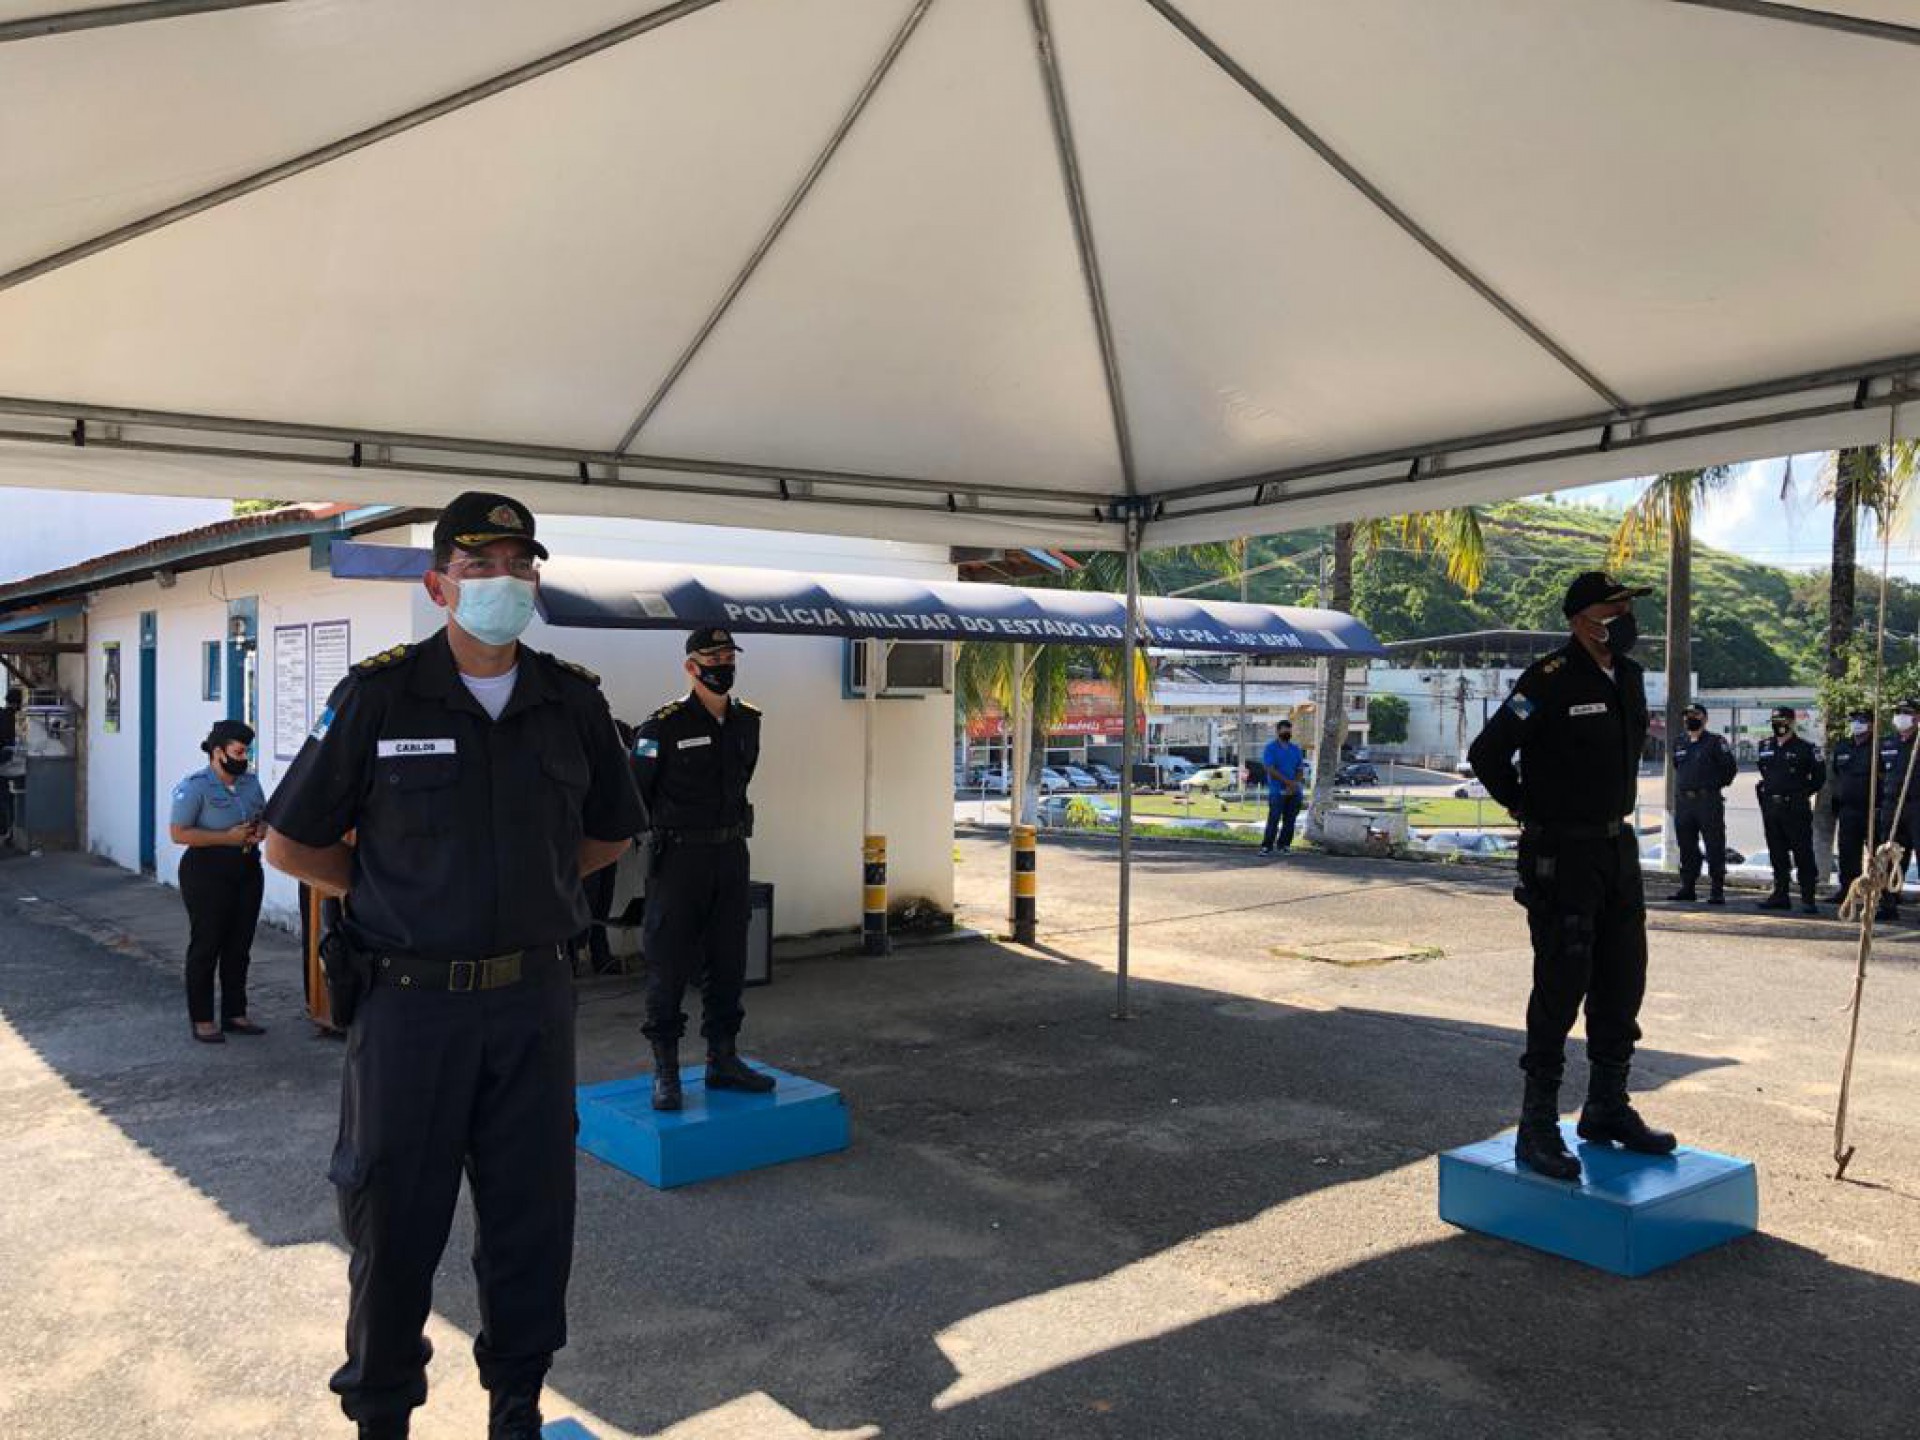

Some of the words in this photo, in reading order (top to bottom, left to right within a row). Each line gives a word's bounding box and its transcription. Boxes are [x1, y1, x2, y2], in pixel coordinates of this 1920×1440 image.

[723, 602, 845, 627] POLÍCIA
[847, 609, 956, 631] MILITAR
[957, 614, 995, 633] DO
[997, 618, 1088, 637] ESTADO
[1088, 622, 1124, 638] DO
[395, 743, 436, 753] CARLOS
